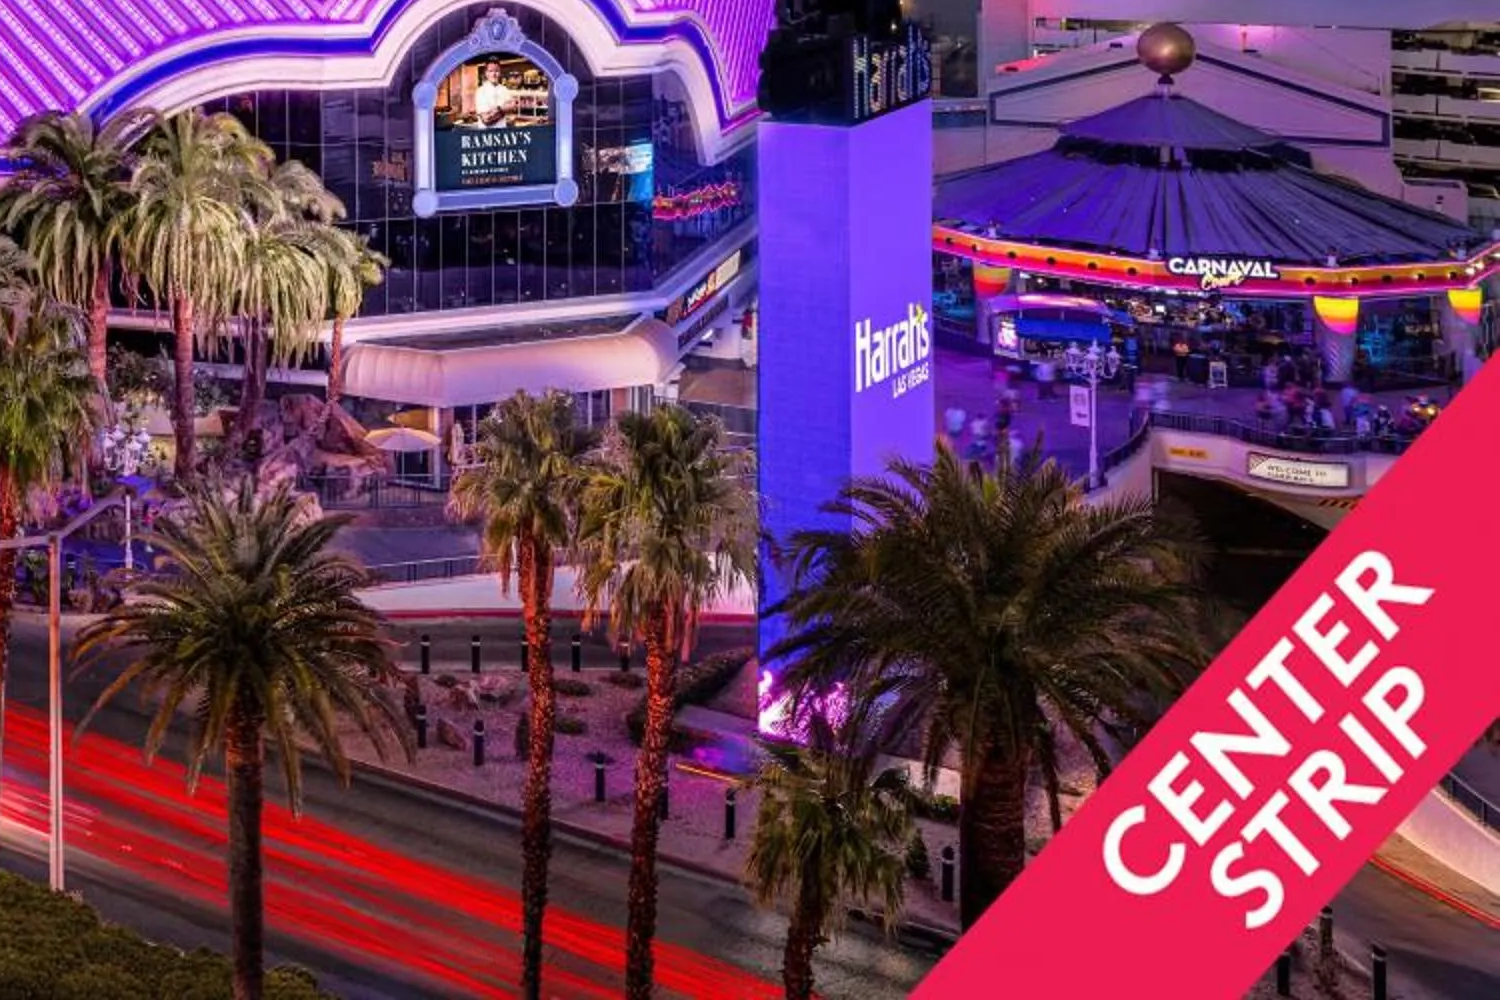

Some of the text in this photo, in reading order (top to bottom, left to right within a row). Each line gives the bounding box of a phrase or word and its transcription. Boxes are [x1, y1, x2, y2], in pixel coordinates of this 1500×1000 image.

[461, 130, 533, 149] RAMSAY'S
[461, 148, 529, 167] KITCHEN
[1168, 256, 1279, 279] CARNAVAL
